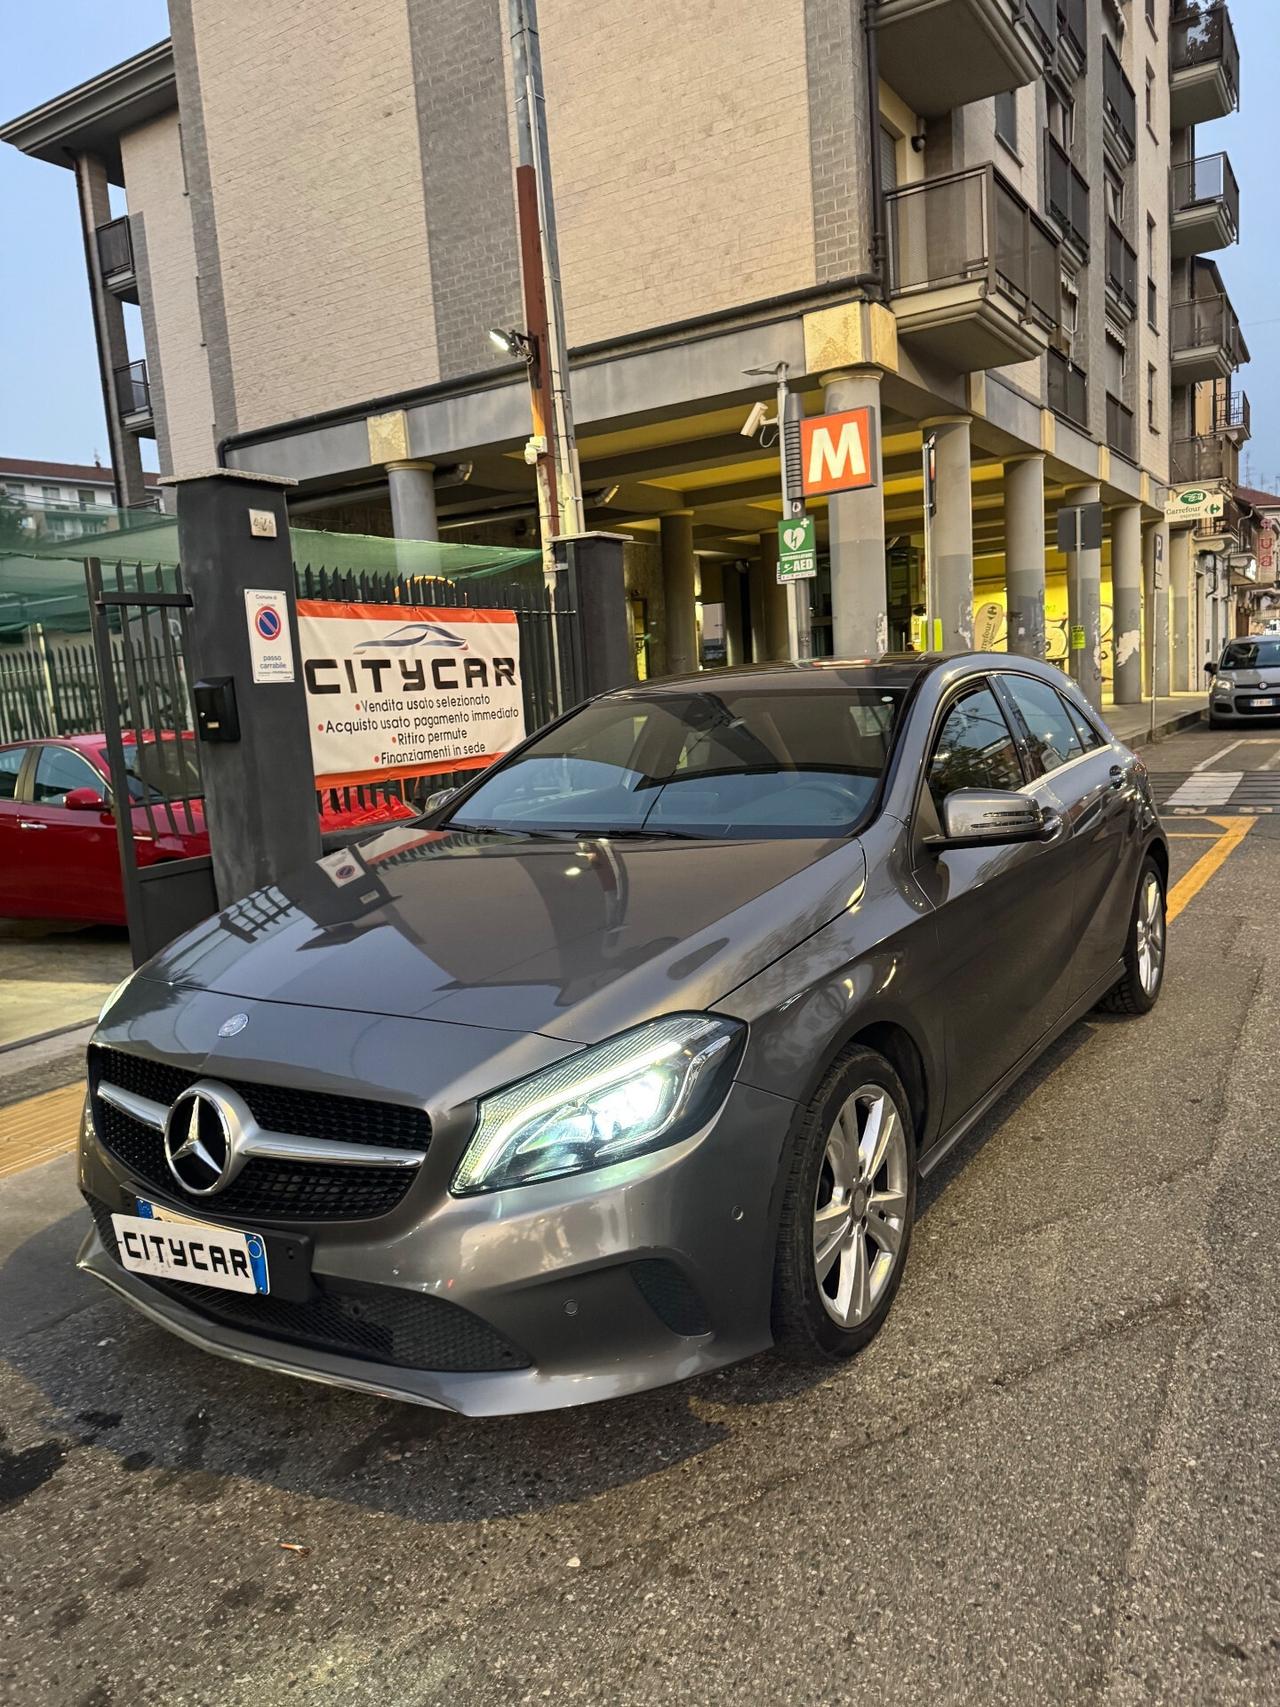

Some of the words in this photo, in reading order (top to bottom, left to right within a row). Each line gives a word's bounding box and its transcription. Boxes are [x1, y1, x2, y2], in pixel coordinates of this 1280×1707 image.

[808, 422, 866, 483] M
[1166, 506, 1200, 515] Carrefour
[1156, 535, 1162, 558] P
[793, 559, 813, 572] AED
[263, 655, 282, 663] passo
[304, 657, 517, 694] CITYCAR
[361, 699, 403, 713] Vendita
[406, 699, 434, 711] usato
[436, 694, 491, 708] selezionato
[326, 719, 378, 735] Acquisto
[380, 717, 411, 729] usato
[414, 713, 470, 730] pagamento
[471, 707, 519, 721] immediato
[397, 731, 425, 746] Ritiro
[428, 728, 468, 744] permute
[381, 748, 451, 765] Finanziamenti
[452, 747, 462, 757] in
[463, 743, 486, 755] sede
[123, 1231, 250, 1278] CITYCAR
